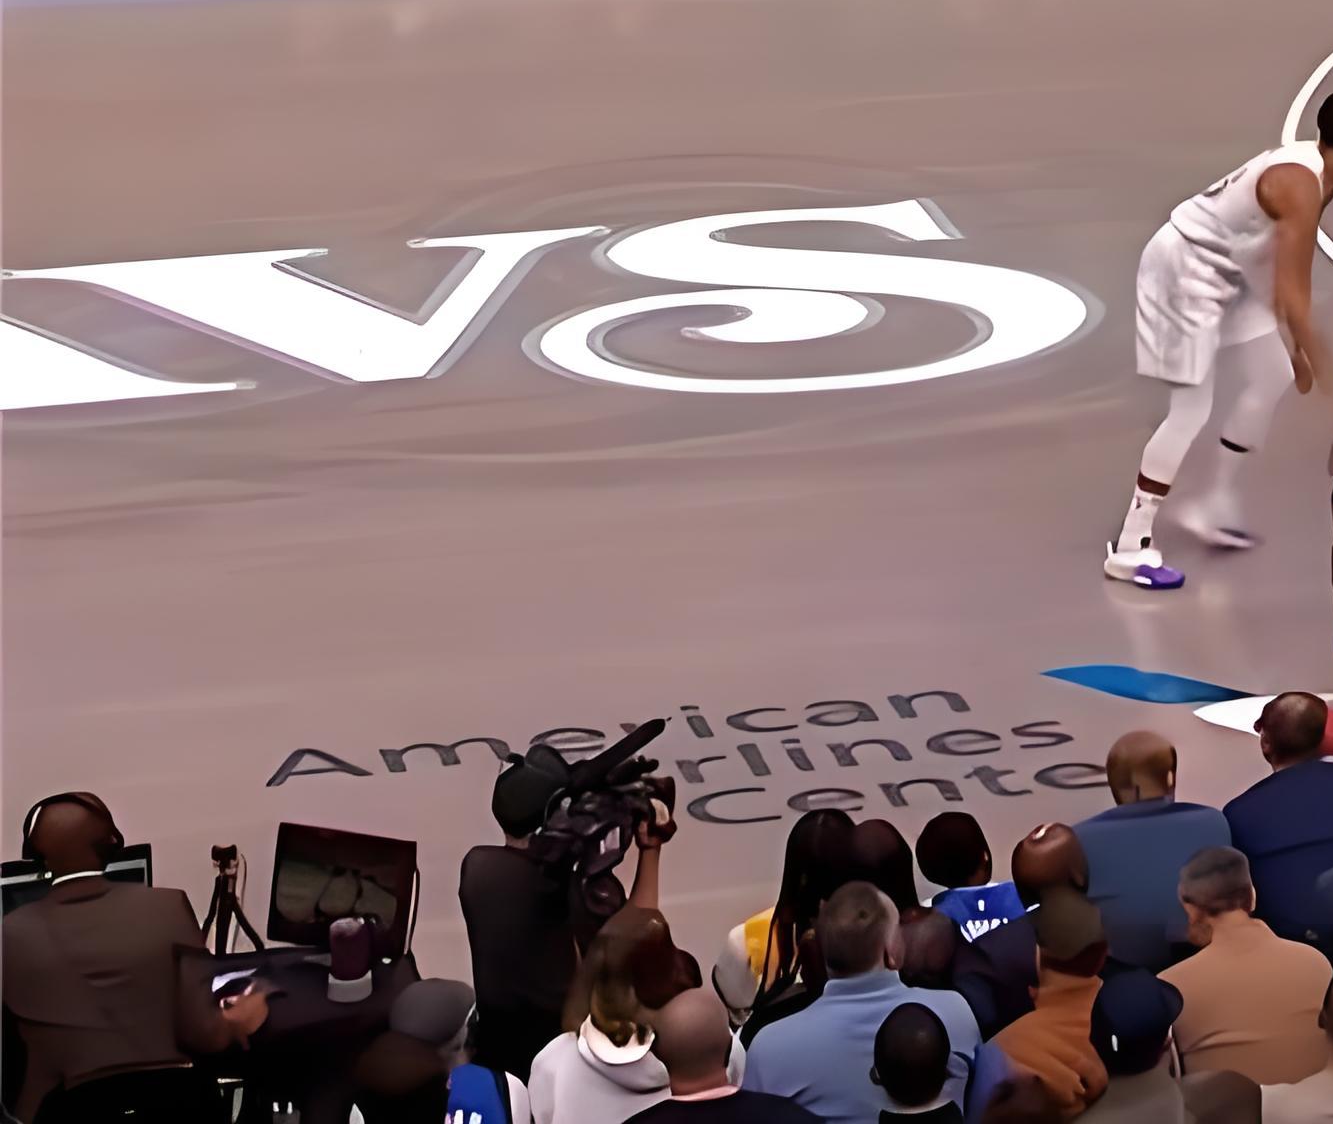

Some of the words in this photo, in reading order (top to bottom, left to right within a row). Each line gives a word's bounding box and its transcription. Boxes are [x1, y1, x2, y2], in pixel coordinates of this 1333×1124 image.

[266, 690, 971, 787] Ameican
[675, 720, 1075, 784] rlines
[687, 762, 1109, 825] Cente
